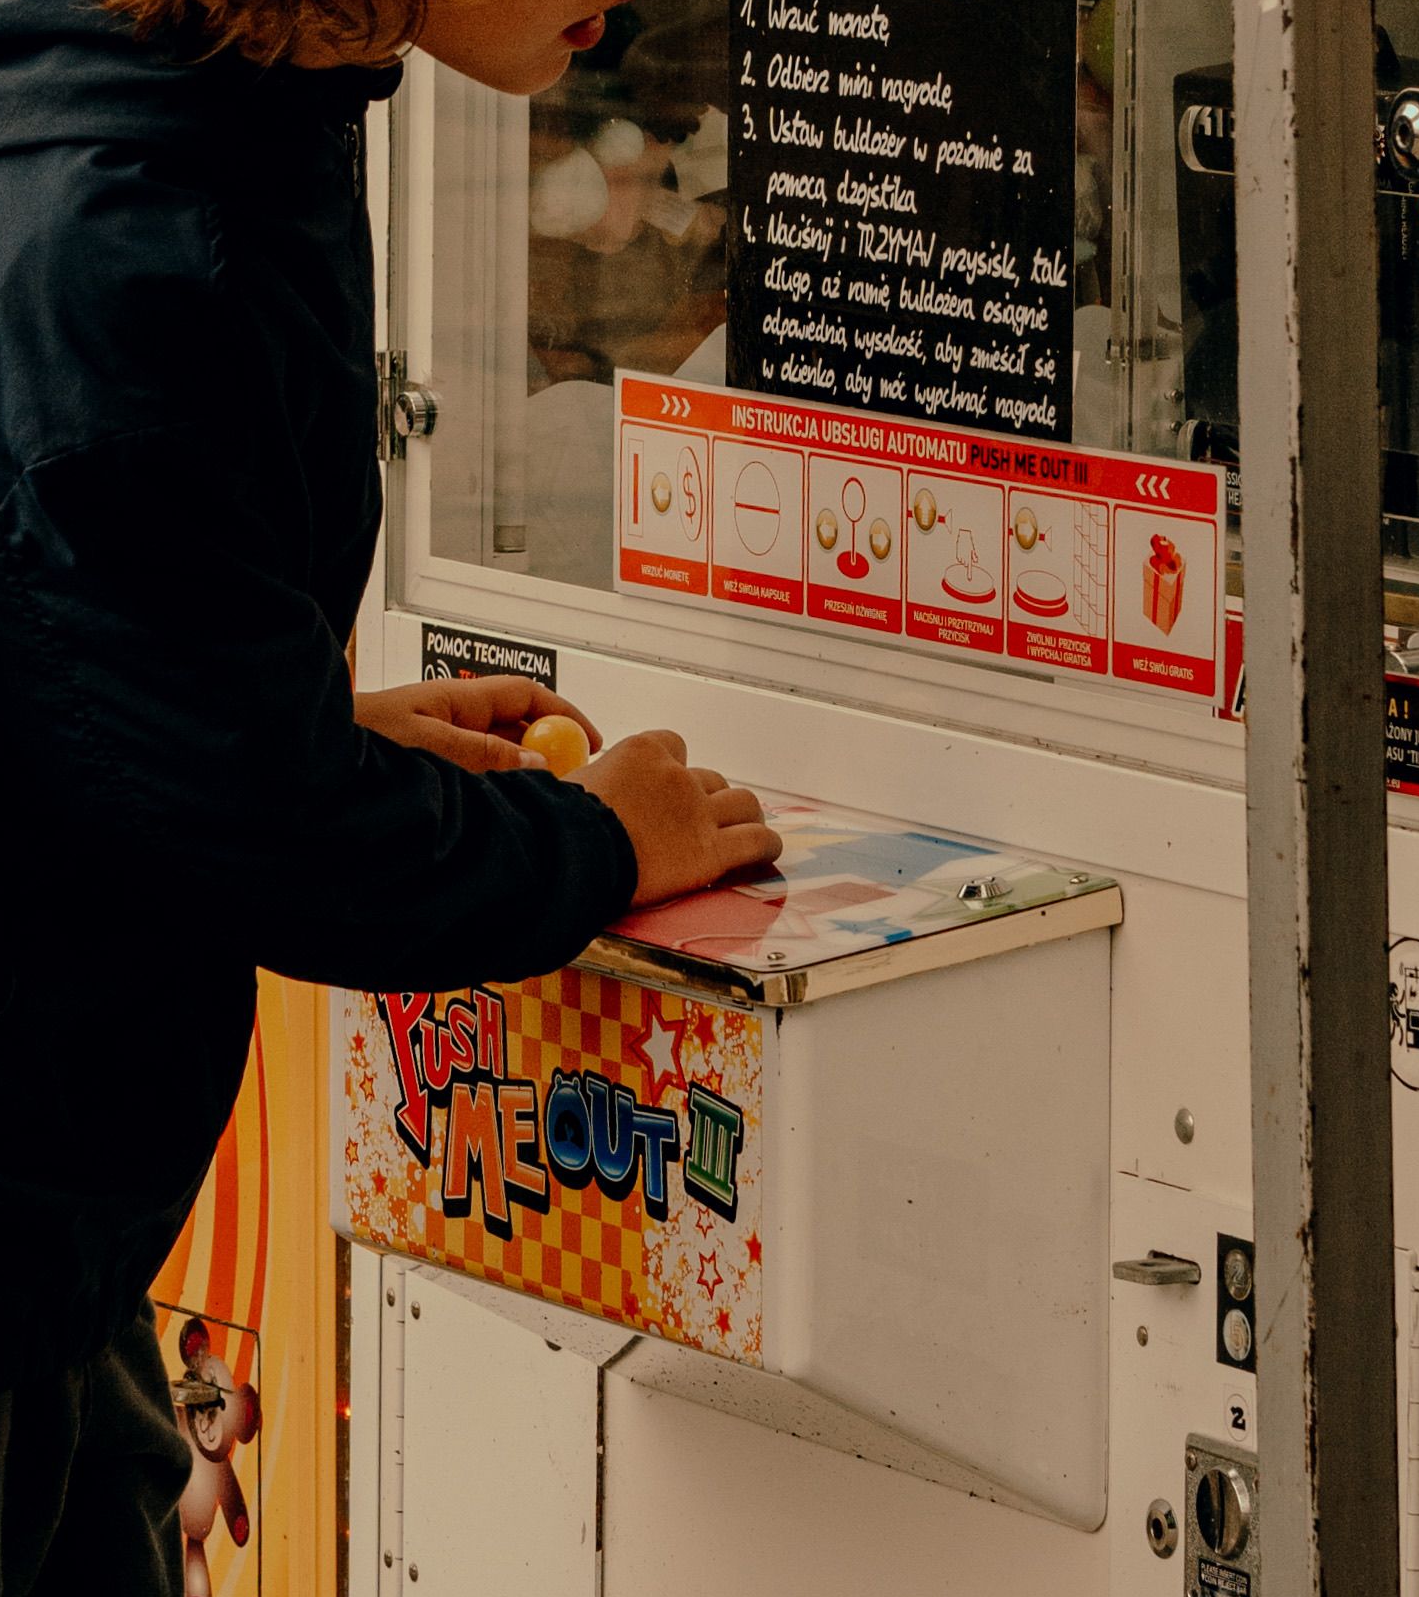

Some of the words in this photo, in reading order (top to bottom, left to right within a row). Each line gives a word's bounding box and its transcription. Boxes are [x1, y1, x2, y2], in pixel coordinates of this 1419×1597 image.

[828, 4, 891, 47] monetę
[740, 50, 756, 87] 2.
[767, 53, 830, 94] Odbierz
[838, 61, 876, 99] mini
[881, 71, 952, 114] nagrodę
[742, 103, 757, 141] 3.
[769, 106, 824, 149] Ustaw
[833, 115, 907, 158] buldożer
[913, 136, 928, 163] w
[935, 131, 1004, 174] poziomie
[1012, 148, 1035, 177] za
[767, 170, 827, 208] pomocą
[767, 211, 834, 262] Naciśnij
[840, 220, 850, 254] i
[856, 221, 937, 268] TRZYMAJ
[1030, 247, 1068, 288] tak
[764, 256, 814, 302] długo,
[821, 270, 842, 299] aż
[847, 273, 891, 313] ramię
[899, 277, 976, 321] buldożera
[982, 291, 1050, 336] osiągnie
[762, 307, 849, 353] odpowiednią
[854, 324, 927, 366] wysokość,
[934, 333, 964, 374] aby
[970, 341, 1031, 377] zmieścił
[1033, 348, 1057, 385] się
[762, 357, 776, 380] w
[844, 363, 873, 404] aby
[879, 372, 908, 402] móc
[914, 380, 989, 420] wypchnąć
[994, 394, 1057, 431] nagrodę
[731, 404, 820, 442] INSTRUKCJA
[821, 419, 885, 454] UBSŁUGI
[886, 434, 967, 466] AUTOMATU
[970, 444, 1011, 473] PUSH
[1013, 452, 1036, 478] ME
[1039, 457, 1070, 483] OUT
[1072, 462, 1089, 486] III
[641, 563, 663, 579] WRZUĆ
[663, 568, 690, 586] MONETĘ
[723, 579, 738, 594] WEŹ
[738, 581, 760, 599] SWOJĄ
[760, 586, 791, 605] KAPSUŁĘ
[824, 598, 854, 615] PRZESUŃ
[854, 605, 888, 624] DŹWIGNIĘ
[913, 610, 944, 627] NACIŚNIJ
[947, 616, 994, 636] PRZYTRZYMAJ
[426, 631, 471, 659] POMOC
[473, 641, 552, 677] TECHNICZNA
[938, 627, 971, 644] PRZYCISK
[1026, 632, 1056, 650] ZWOLNIJ
[1058, 638, 1092, 655] PRZYCISK
[1030, 648, 1063, 665] WYPCHAJ
[1063, 653, 1092, 668] GRATISA
[1132, 656, 1149, 673] WEŹ
[1149, 659, 1169, 678] SWÓJ
[1169, 665, 1194, 681] GRATIS
[380, 988, 505, 1152] PUSH
[443, 1081, 548, 1224] ME
[547, 1072, 676, 1204] OUT
[685, 1086, 740, 1207] III
[1230, 1405, 1246, 1432] 2
